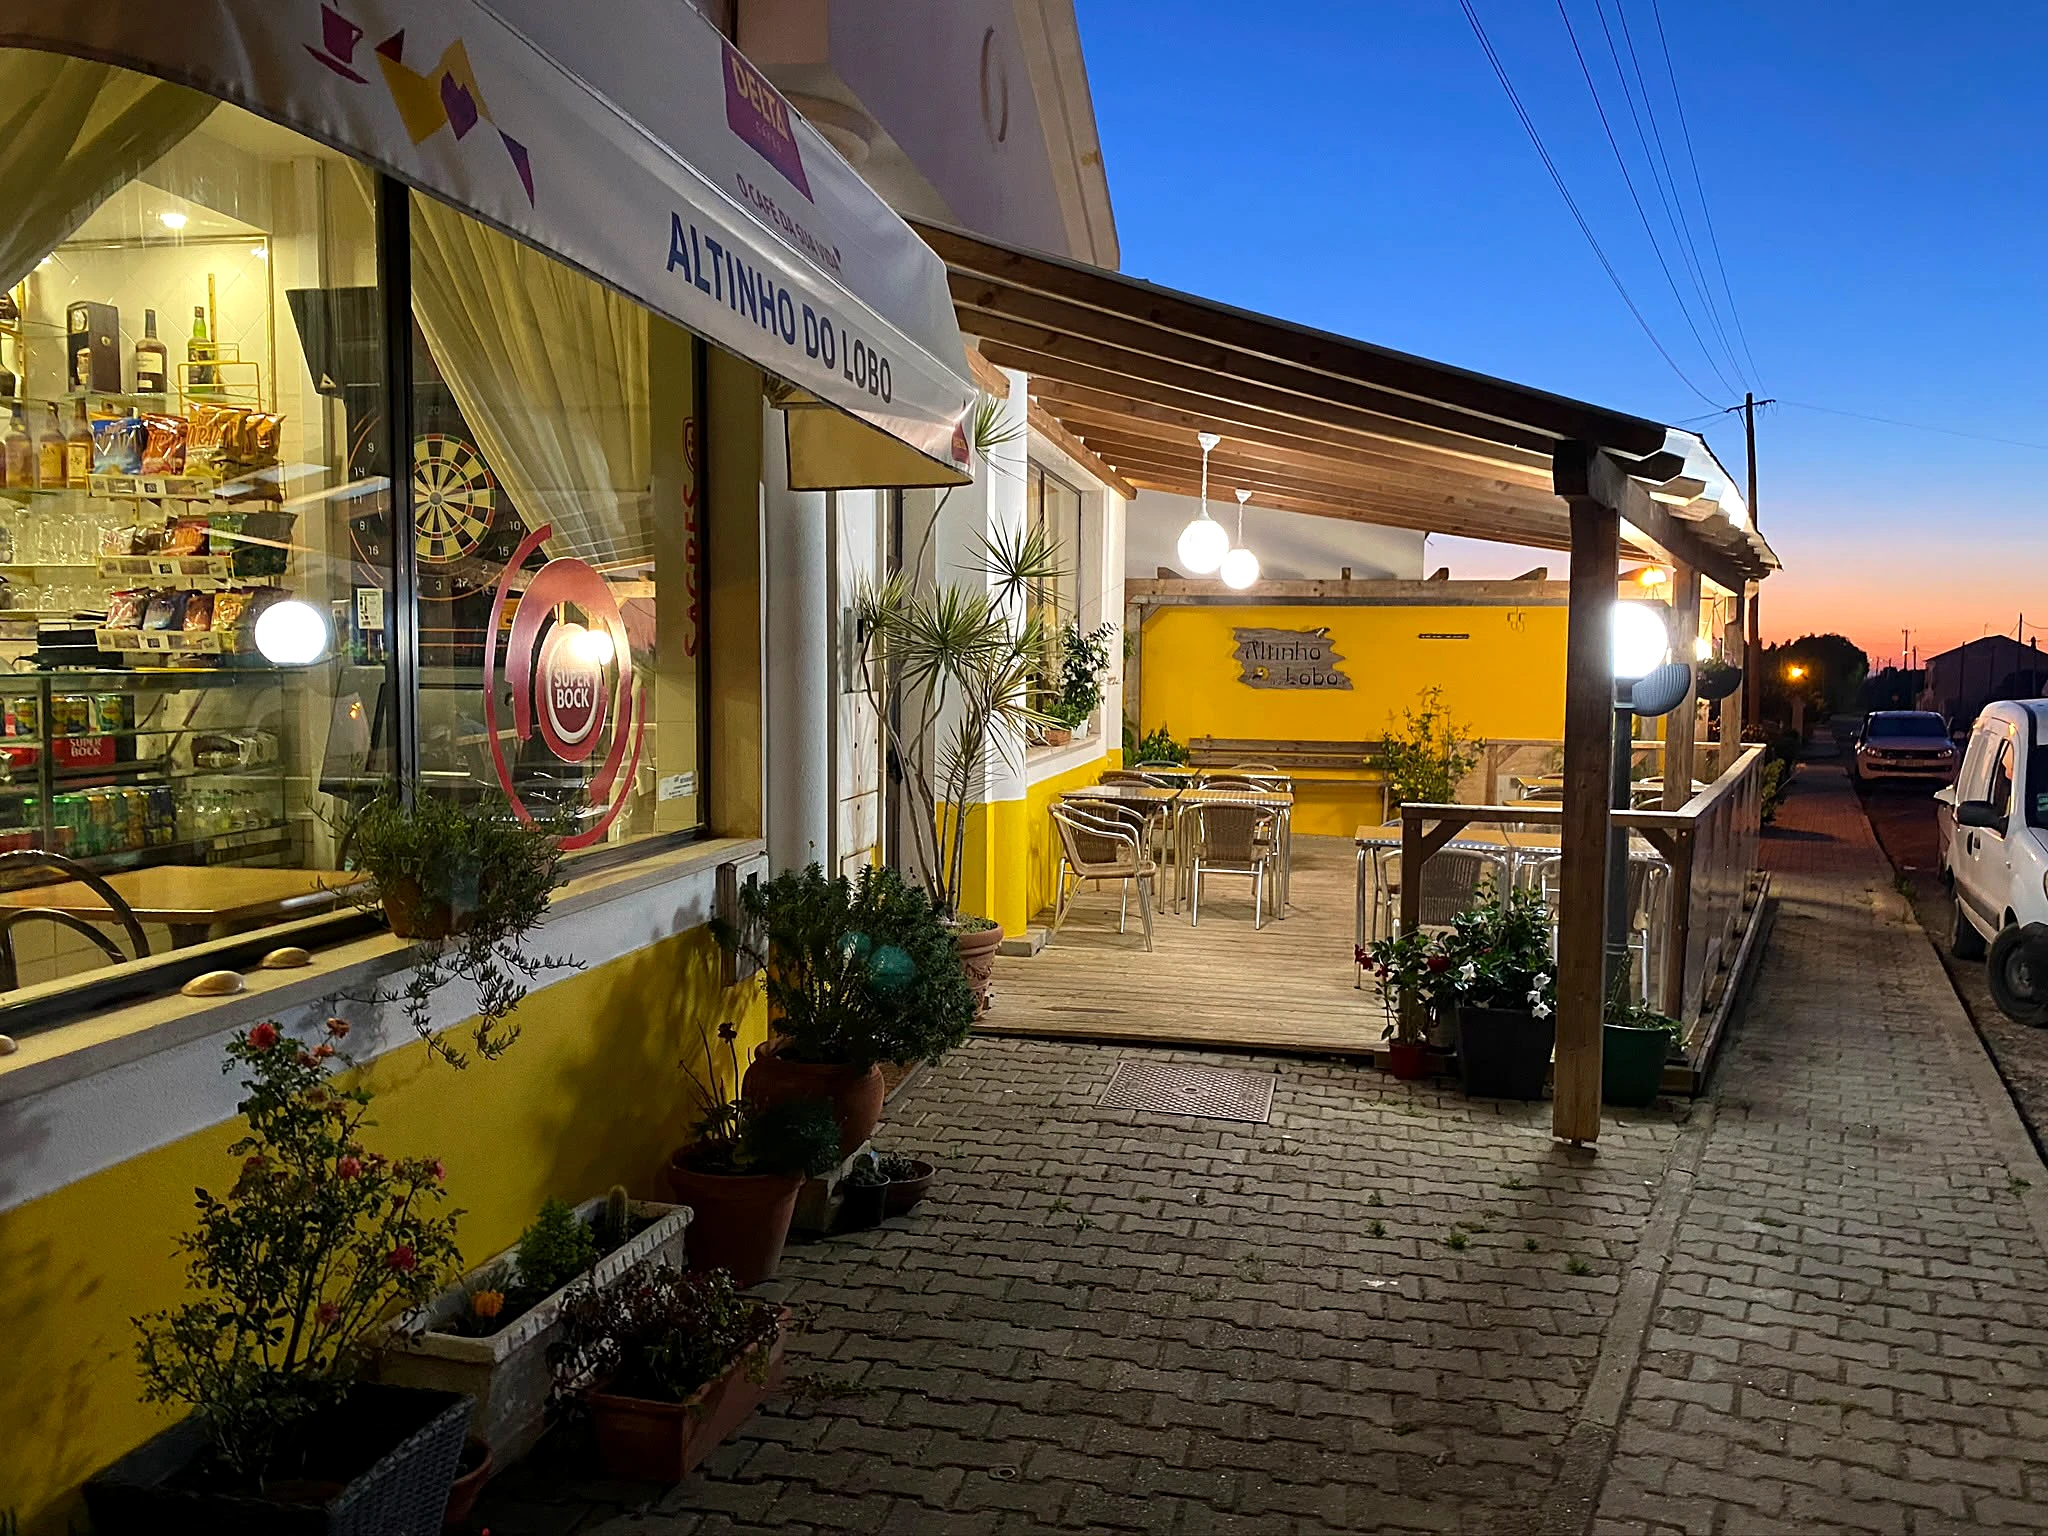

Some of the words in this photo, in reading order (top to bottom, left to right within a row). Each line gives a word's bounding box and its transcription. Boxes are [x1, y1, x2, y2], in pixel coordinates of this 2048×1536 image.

[731, 54, 790, 141] DELTA
[736, 173, 747, 198] O
[779, 208, 797, 238] DA
[666, 211, 796, 345] ALTINHO
[802, 303, 836, 370] DO
[841, 329, 893, 404] LOBO
[1245, 640, 1321, 660] Altinho
[554, 671, 591, 688] SUPER
[556, 687, 590, 709] BOCK
